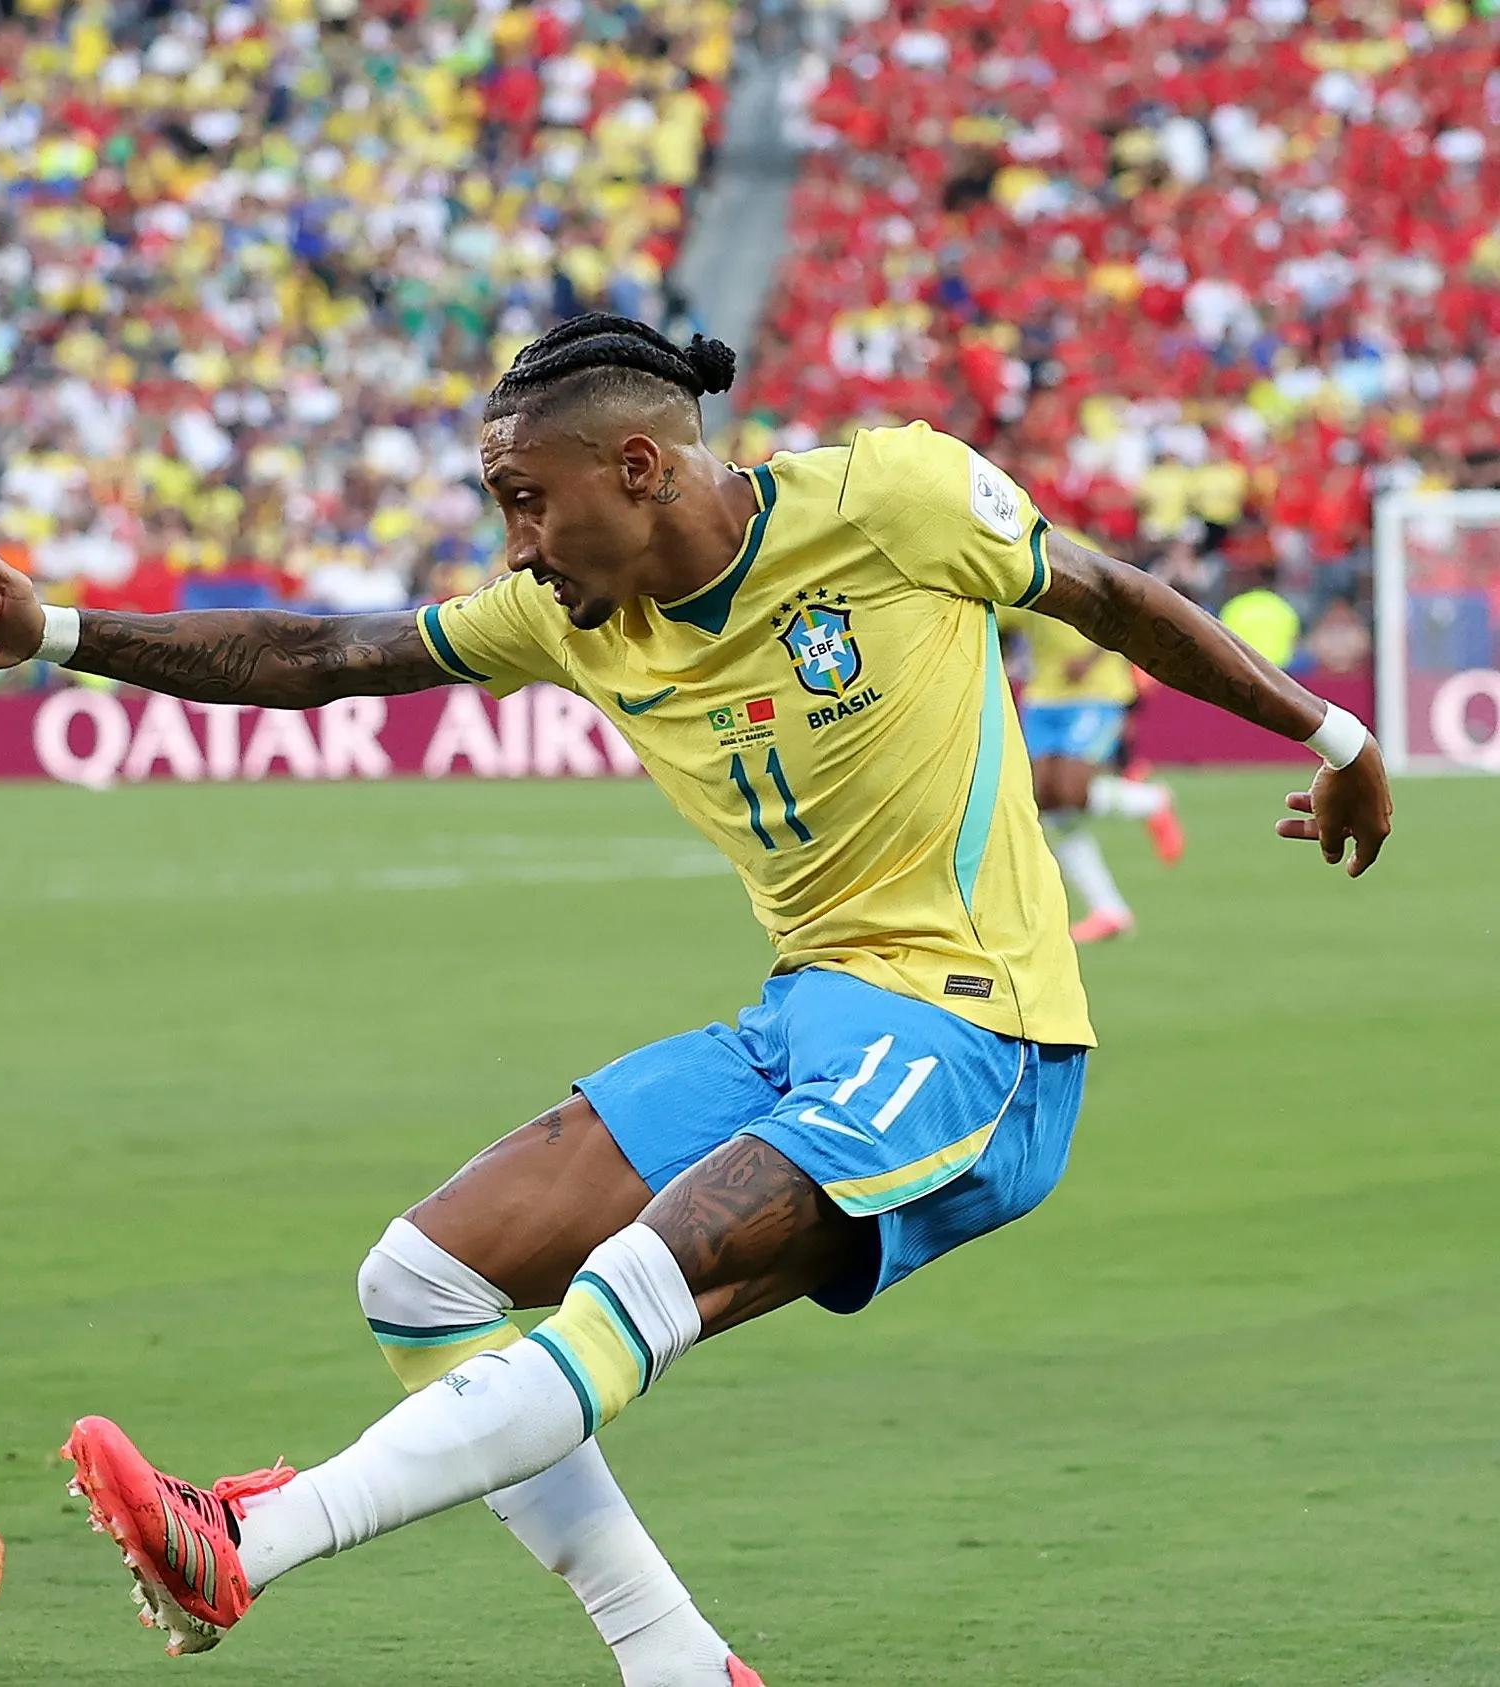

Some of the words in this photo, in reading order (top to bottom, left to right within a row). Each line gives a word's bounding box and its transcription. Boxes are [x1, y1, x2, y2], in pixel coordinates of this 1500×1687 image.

[808, 639, 835, 658] CBF
[32, 686, 394, 791] QATAR
[806, 687, 884, 731] BRASIL
[729, 747, 814, 850] 11
[829, 1032, 940, 1135] 11
